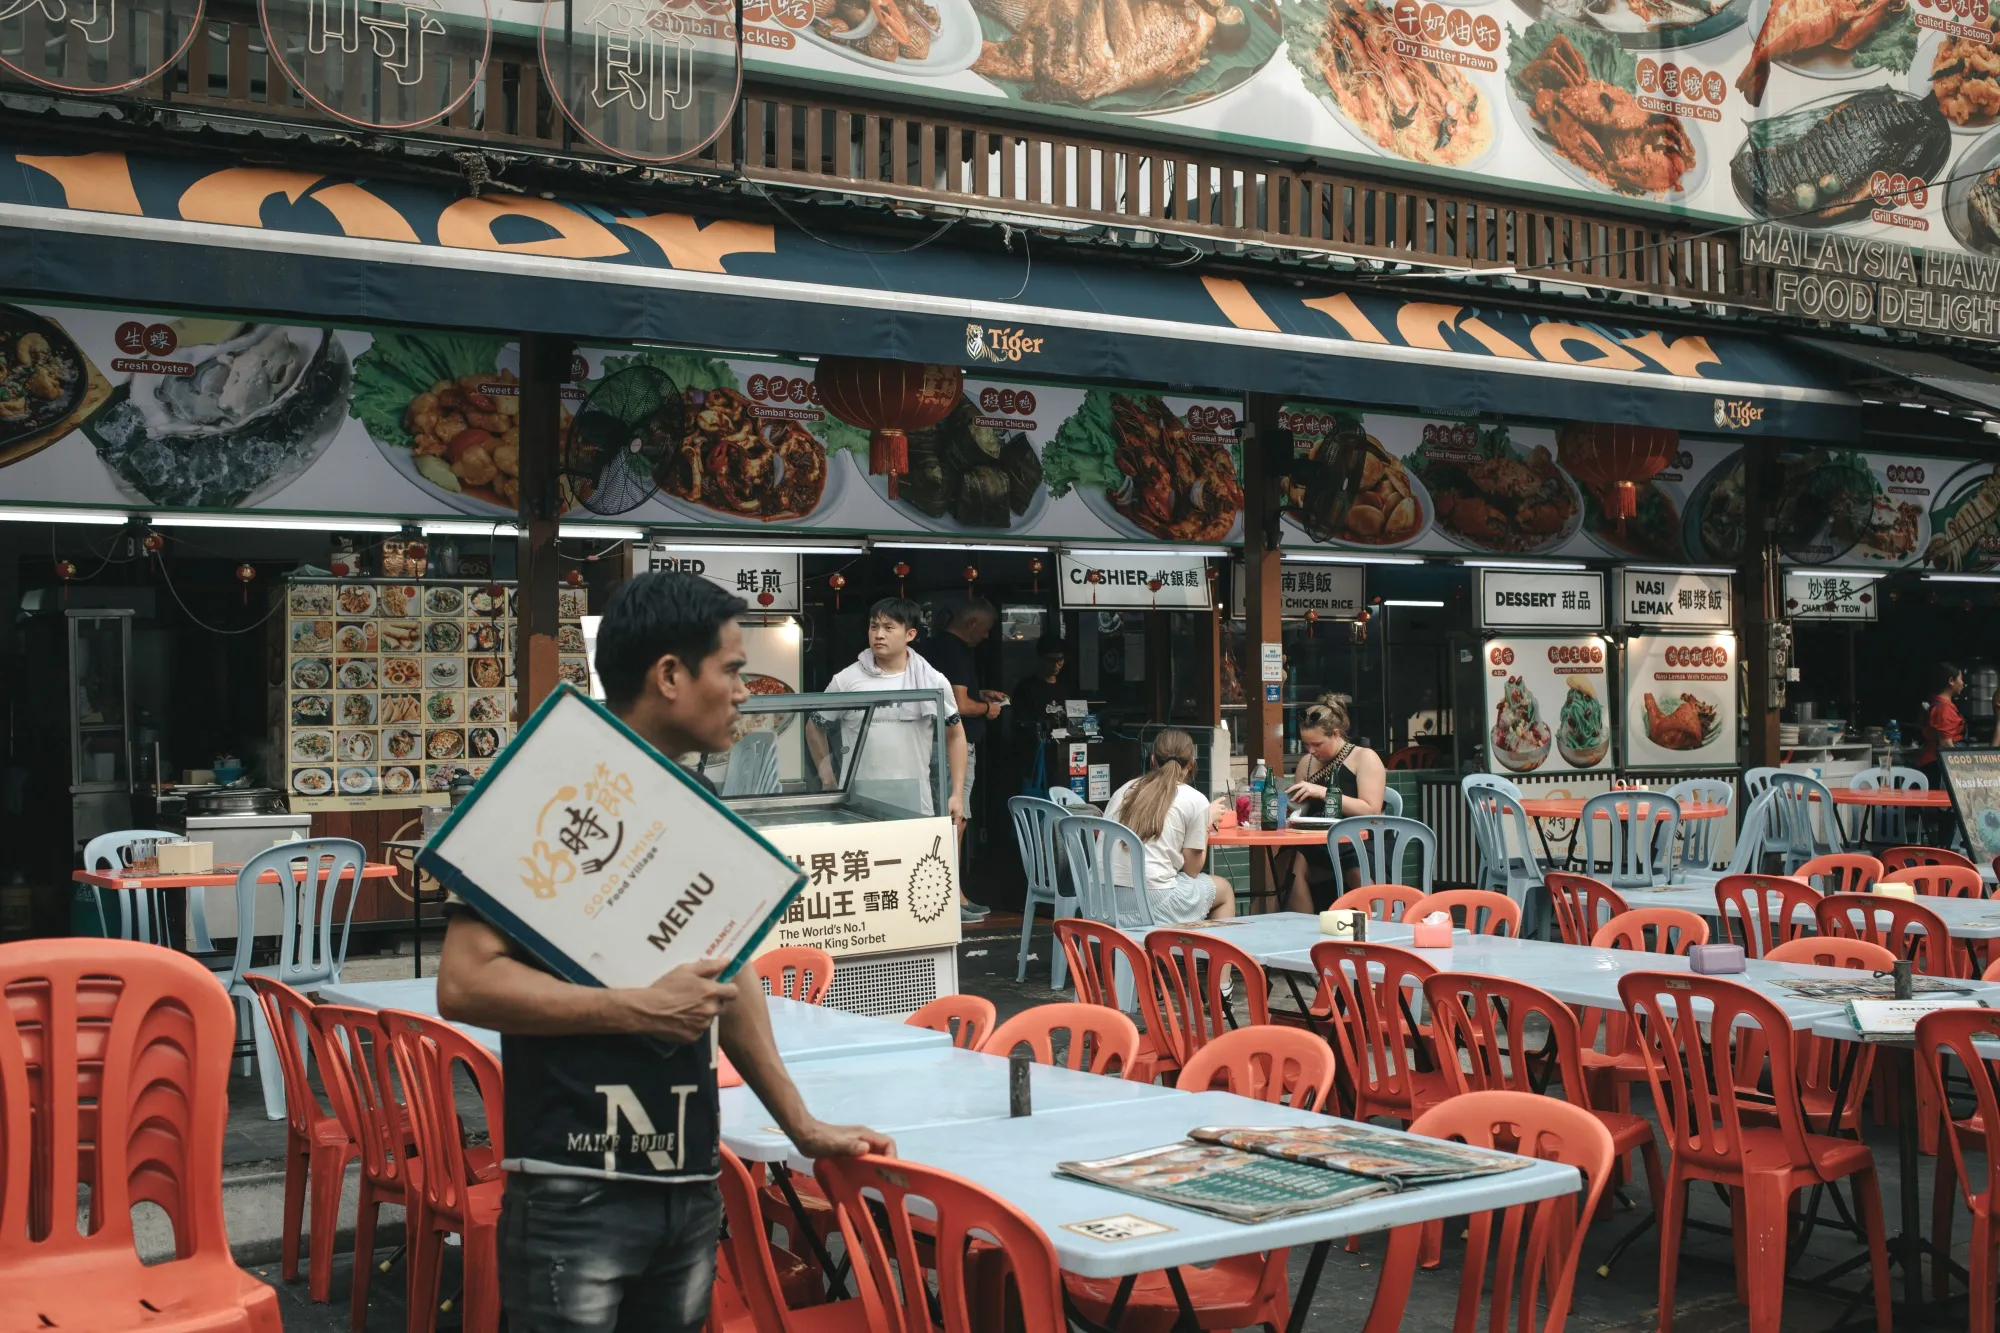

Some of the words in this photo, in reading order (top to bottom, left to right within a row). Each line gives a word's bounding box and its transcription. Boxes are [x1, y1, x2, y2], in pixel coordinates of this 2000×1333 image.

[652, 14, 717, 36] Sambal
[1918, 14, 1944, 29] Salted
[1945, 21, 1961, 36] Egg
[1963, 26, 1991, 43] Sotong
[1397, 40, 1418, 56] Dry
[1421, 45, 1456, 62] Butter
[1459, 52, 1494, 70] Prawn
[1641, 97, 1673, 112] Salted
[1674, 103, 1694, 117] Egg
[1696, 107, 1719, 120] Crab
[1873, 210, 1891, 223] Grill
[1892, 214, 1926, 231] Stingray
[1743, 223, 1918, 284] MALAYSIA
[1775, 272, 1874, 321] FOOD
[987, 327, 1044, 361] Tiger
[117, 360, 148, 371] Fresh
[151, 362, 189, 374] Oyster
[481, 385, 512, 395] Sweet
[754, 407, 786, 417] Sambal
[788, 410, 819, 421] Sotong
[975, 417, 1003, 427] Pandan
[1005, 419, 1035, 429] Chicken
[1727, 400, 1764, 427] Tiger
[1191, 434, 1217, 443] Sambal
[1217, 435, 1239, 444] Prawn
[1297, 440, 1311, 448] Lala
[1425, 450, 1445, 458] Salted
[1445, 452, 1466, 461] Pepper
[1467, 453, 1481, 461] Crab
[650, 558, 706, 575] FRIED
[736, 568, 783, 594] 蚝煎
[1635, 580, 1665, 596] NASI
[1285, 598, 1329, 609] CHICKEN
[1331, 599, 1354, 610] RICE
[1495, 591, 1557, 608] DESSERT
[1561, 590, 1591, 611] 甜品
[1631, 600, 1674, 616] LEMAK
[1841, 604, 1861, 613] TEOW
[1947, 755, 1972, 765] GOOD
[1955, 777, 1976, 789] Nasi
[584, 873, 620, 916] GOOD
[619, 820, 663, 870] TIMING
[606, 879, 631, 907] Food
[627, 845, 659, 880] Village
[862, 889, 900, 913] 雪酪
[646, 871, 716, 953] MENU
[704, 918, 737, 957] BRANCH
[779, 929, 800, 940] The
[801, 924, 842, 938] World's
[843, 921, 867, 934] No.1
[824, 937, 849, 950] King
[850, 932, 887, 946] Sorbet
[594, 1084, 699, 1171] N
